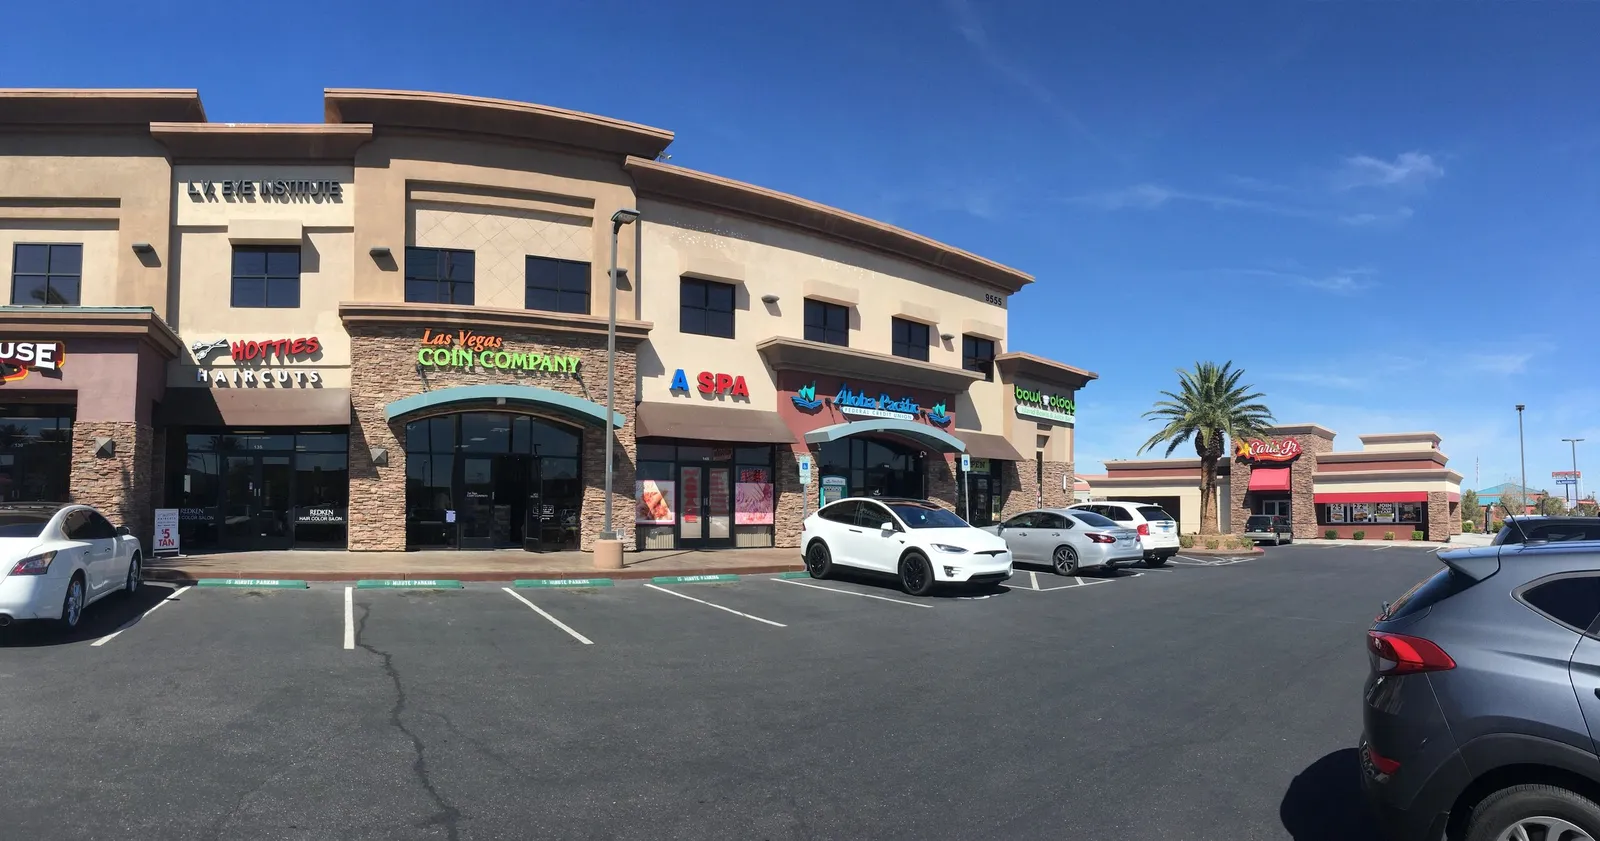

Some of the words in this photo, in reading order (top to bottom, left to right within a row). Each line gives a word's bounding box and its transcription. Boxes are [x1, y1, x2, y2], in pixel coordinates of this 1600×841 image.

[188, 179, 214, 194] L.V.
[222, 179, 251, 194] EYE
[259, 179, 340, 195] INSTITUTE
[985, 293, 1002, 306] 9555
[421, 328, 453, 345] Las
[458, 330, 503, 352] Vegas
[231, 336, 319, 361] HOTTIES
[418, 348, 474, 367] COIN
[479, 350, 582, 373] COMPANY
[197, 367, 319, 382] HAIRCUTS
[669, 368, 690, 391] A
[697, 371, 750, 398] SPA
[833, 387, 876, 409] Aloha
[878, 393, 920, 414] Pacific
[844, 407, 870, 415] FEDERAL
[1281, 440, 1300, 455] Jr.
[970, 461, 986, 469] PEN
[158, 539, 175, 547] TAN
